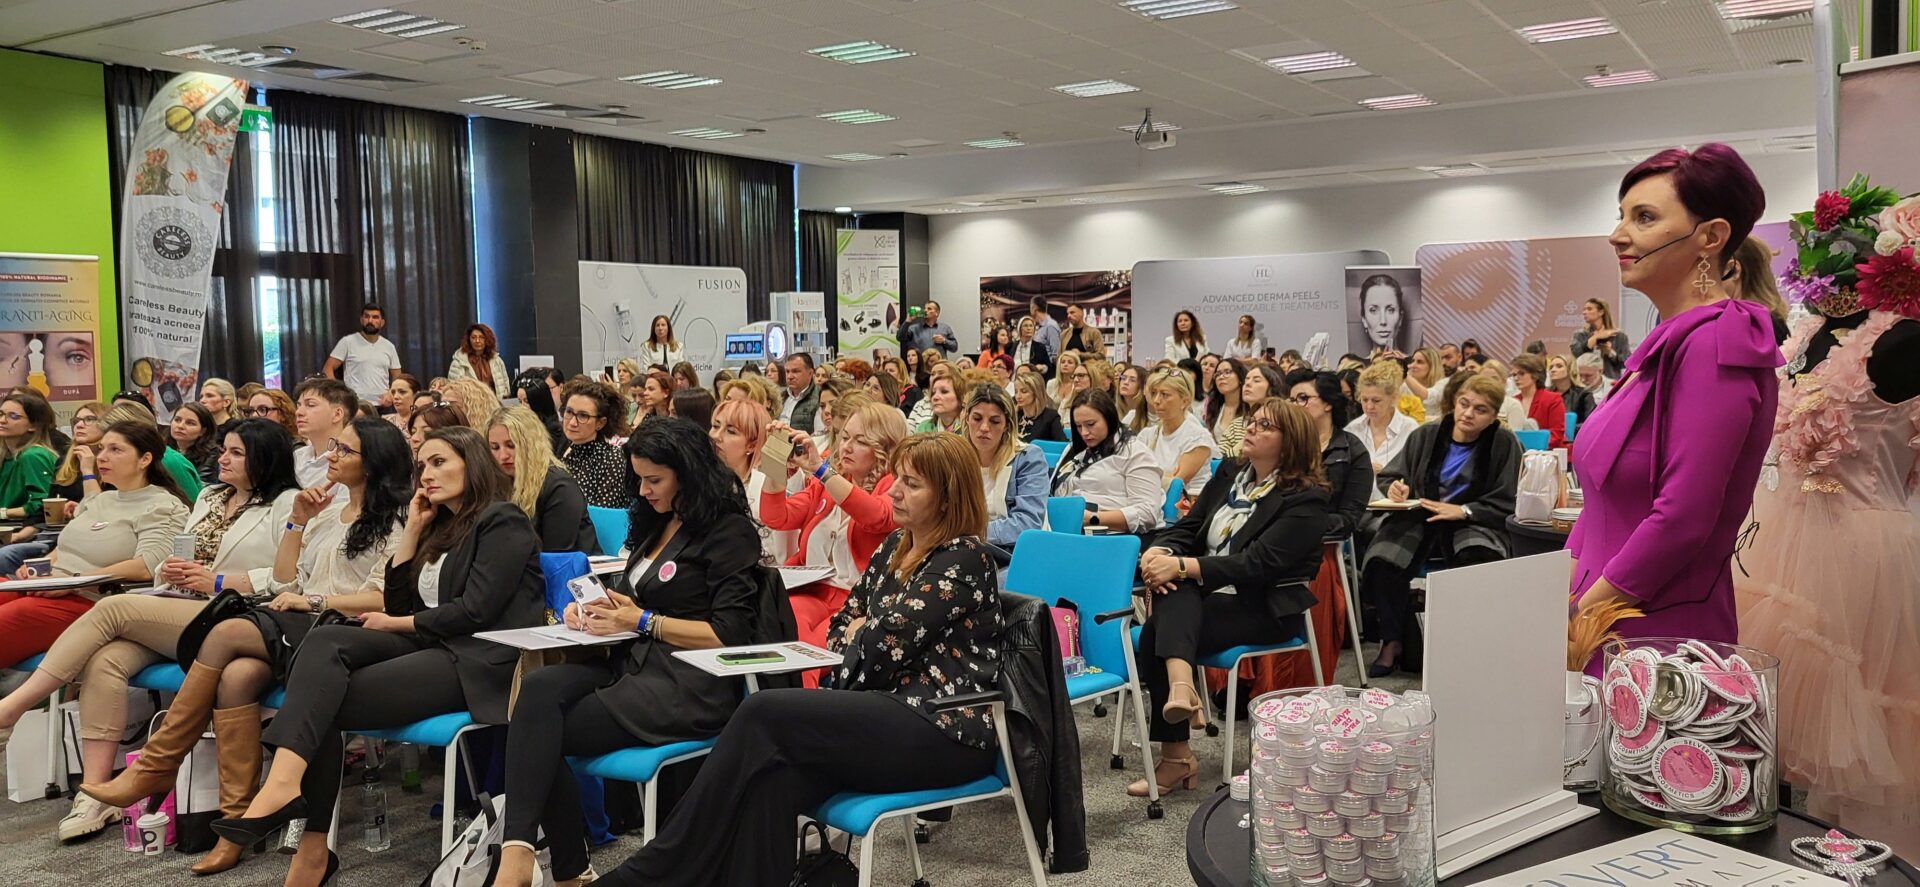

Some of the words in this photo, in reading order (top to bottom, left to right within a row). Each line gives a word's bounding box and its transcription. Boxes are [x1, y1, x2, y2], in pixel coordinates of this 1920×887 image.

[156, 226, 190, 245] CARELESS
[157, 247, 185, 260] BEAUTY
[1255, 268, 1270, 278] HL
[698, 279, 741, 290] FUSION
[1202, 293, 1255, 304] ADVANCED
[1257, 292, 1290, 302] DERMA
[1292, 291, 1320, 300] PEELS
[128, 296, 165, 311] Careless
[168, 304, 205, 319] Beauty
[1203, 302, 1277, 314] CUSTOMIZABLE
[1280, 300, 1339, 311] TREATMENTS
[163, 319, 201, 331] acneea
[132, 325, 154, 338] 100%
[156, 332, 193, 344] natural
[694, 363, 713, 371] dicine
[1683, 740, 1713, 757] SELVERT
[1709, 758, 1720, 789] THERMAL
[1657, 775, 1695, 799] COSMETICS
[1527, 838, 1719, 887] VERT
